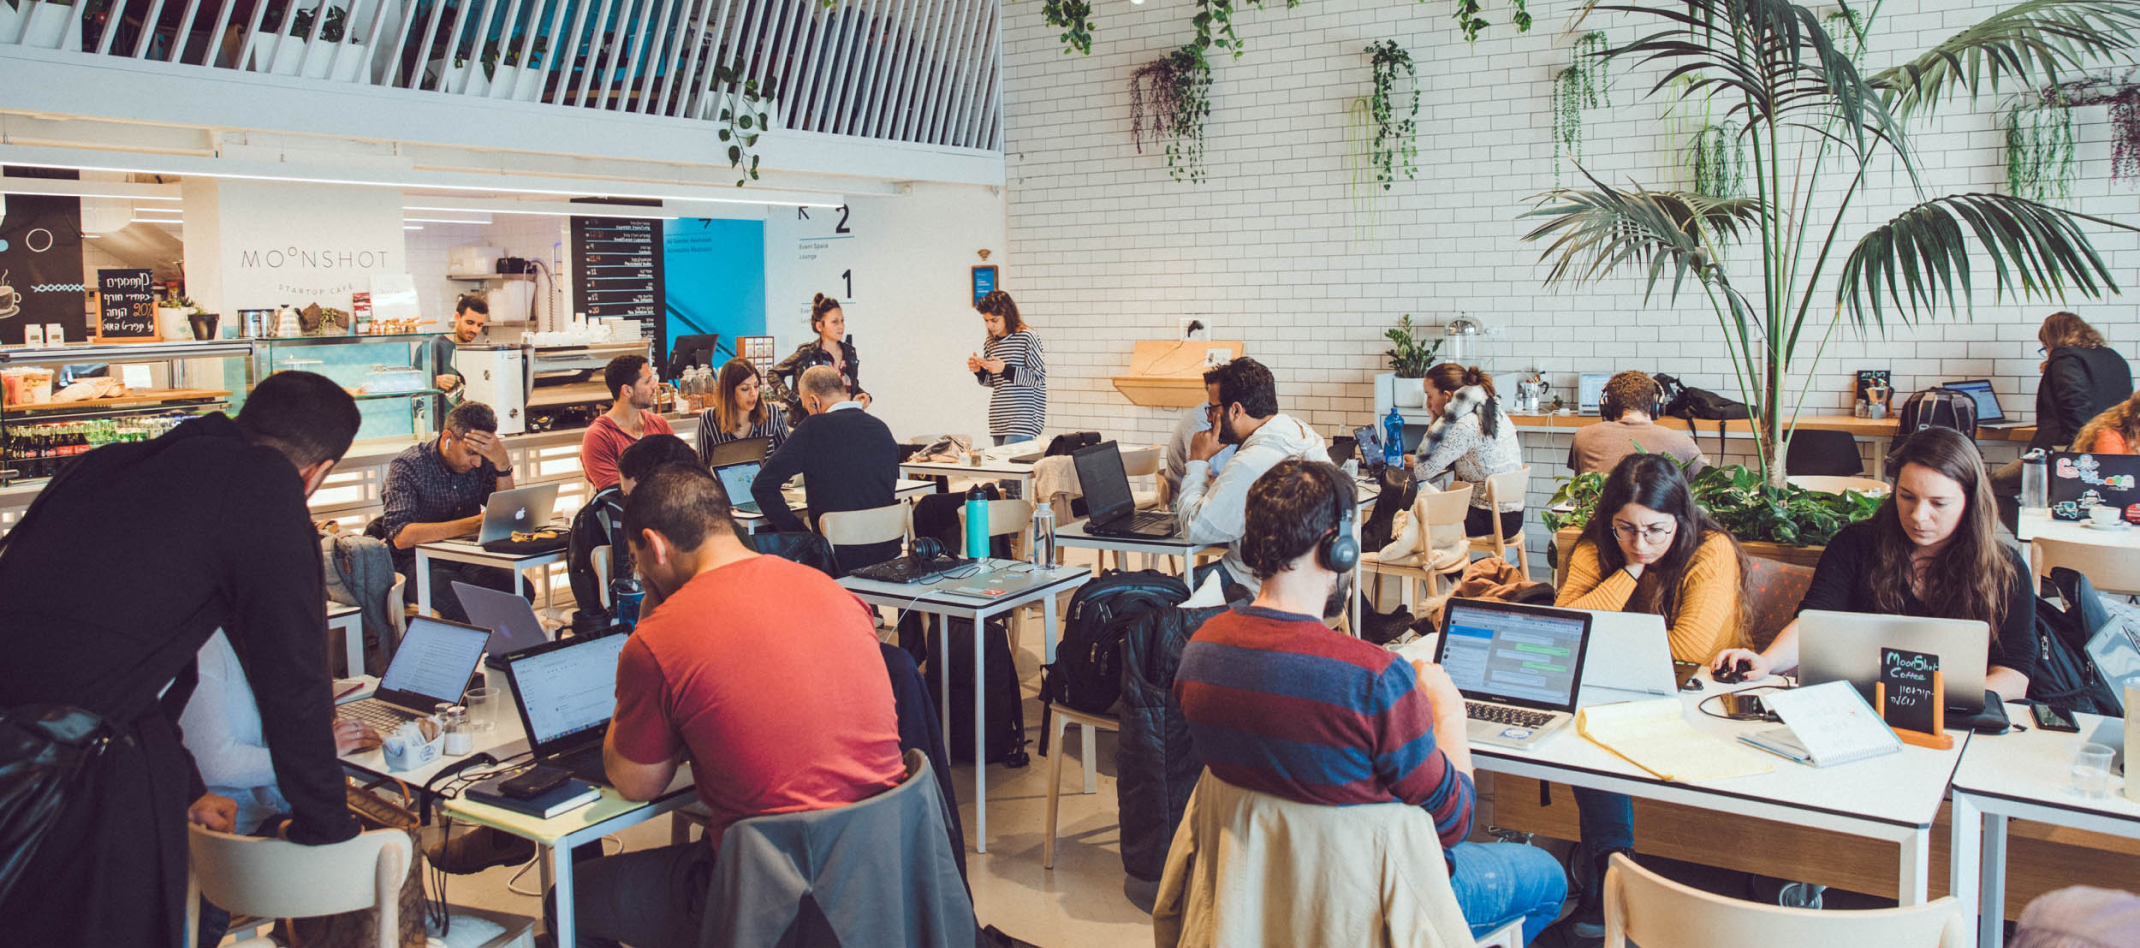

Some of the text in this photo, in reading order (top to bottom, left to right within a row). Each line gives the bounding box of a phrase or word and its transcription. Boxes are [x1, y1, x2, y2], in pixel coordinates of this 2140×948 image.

[835, 204, 850, 233] 2
[842, 269, 851, 298] 1
[1890, 667, 1926, 680] Coffee
